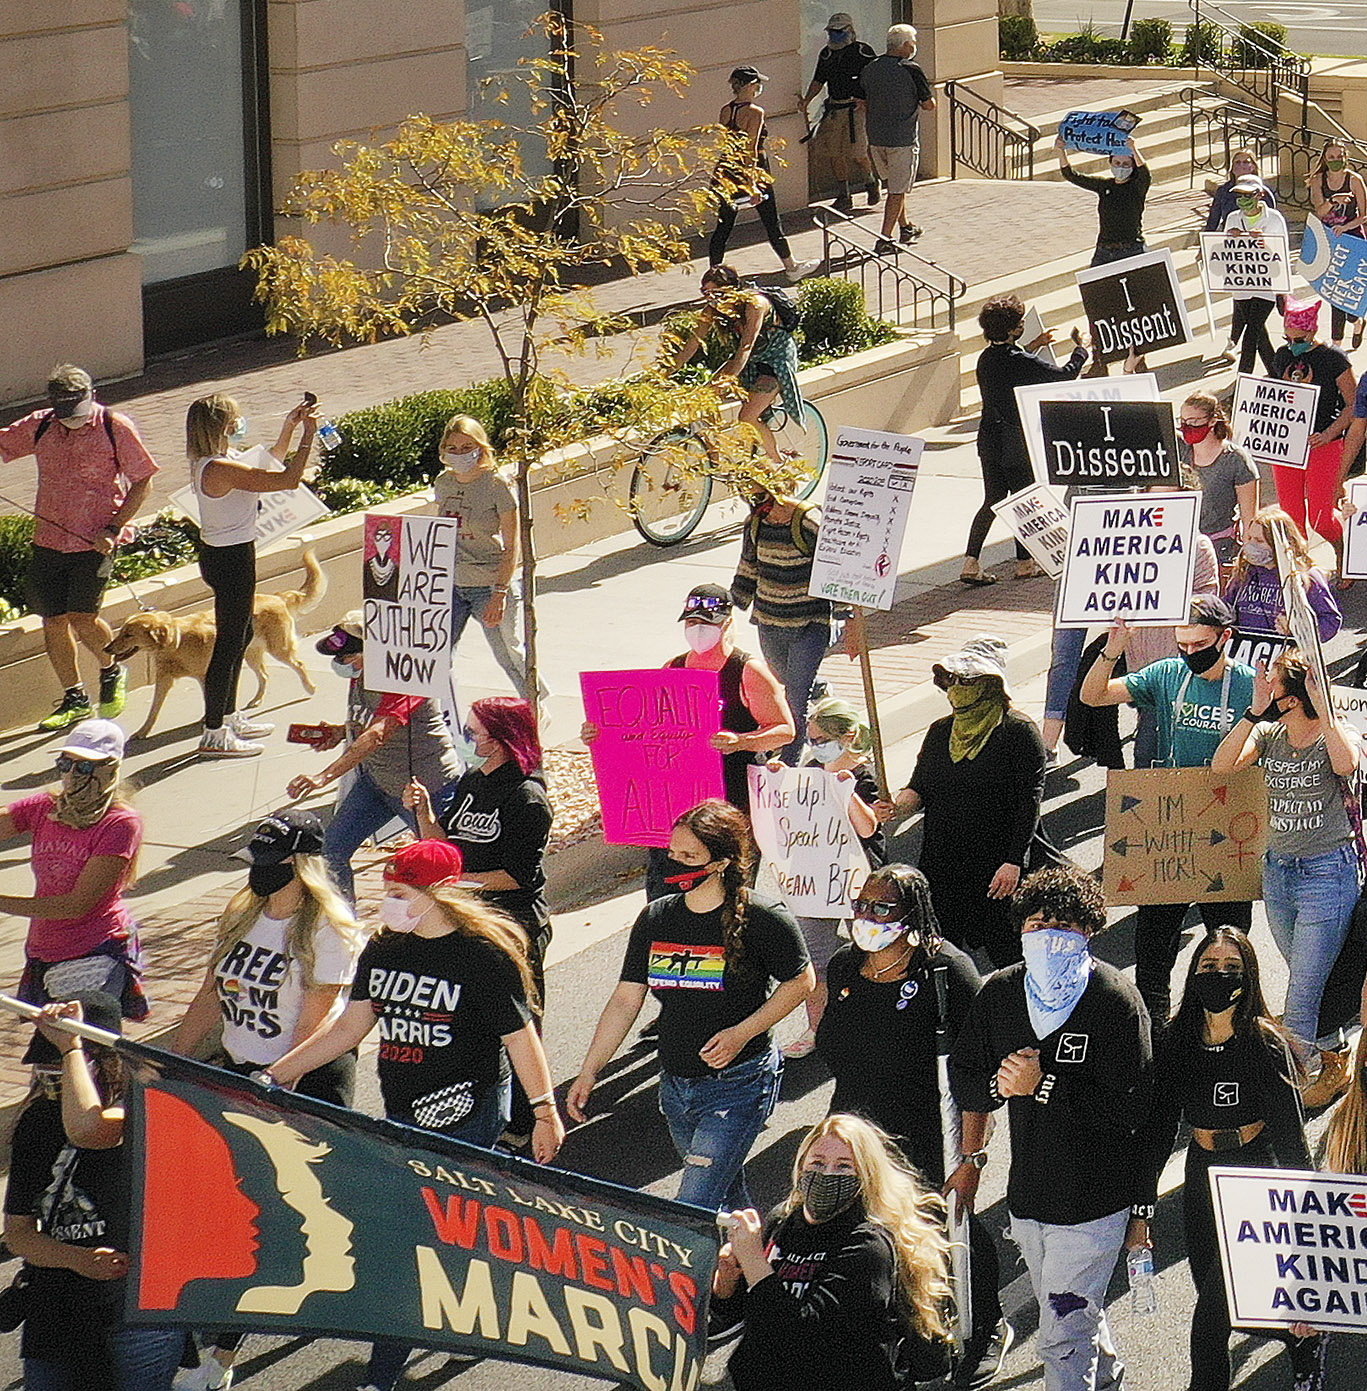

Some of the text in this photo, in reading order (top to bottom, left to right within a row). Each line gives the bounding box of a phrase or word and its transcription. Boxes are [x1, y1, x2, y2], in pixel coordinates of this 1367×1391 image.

[1065, 126, 1125, 146] Protect Her
[1211, 252, 1281, 261] AMERICA
[1224, 240, 1264, 248] MAKE
[1224, 277, 1271, 286] AGAIN
[1226, 264, 1268, 274] KIND
[1321, 244, 1350, 297] RESPECT
[1120, 278, 1135, 312] I
[1332, 280, 1353, 305] HER
[1095, 304, 1176, 353] Dissent
[1101, 407, 1114, 441] I
[1053, 441, 1169, 476] Dissent
[407, 522, 453, 571] WE
[399, 571, 448, 605] ARE
[364, 600, 450, 652] RUTHLESS
[386, 651, 435, 683] NOW
[597, 685, 714, 730] EQUALITY
[643, 744, 680, 769] FOR
[798, 775, 825, 821] Up!
[1264, 772, 1320, 791] EXISTENCE
[1157, 792, 1185, 825] I'M
[779, 817, 848, 858] Speak Up
[1145, 828, 1196, 855] WITH
[827, 863, 861, 906] BIG
[1153, 856, 1198, 883] HER!
[369, 969, 461, 1013] BIDEN
[380, 1045, 424, 1064] 2020
[408, 1160, 692, 1268] SALT LAKE CITY
[1269, 1190, 1367, 1217] MAKE
[421, 1186, 697, 1335] WOMEN'S
